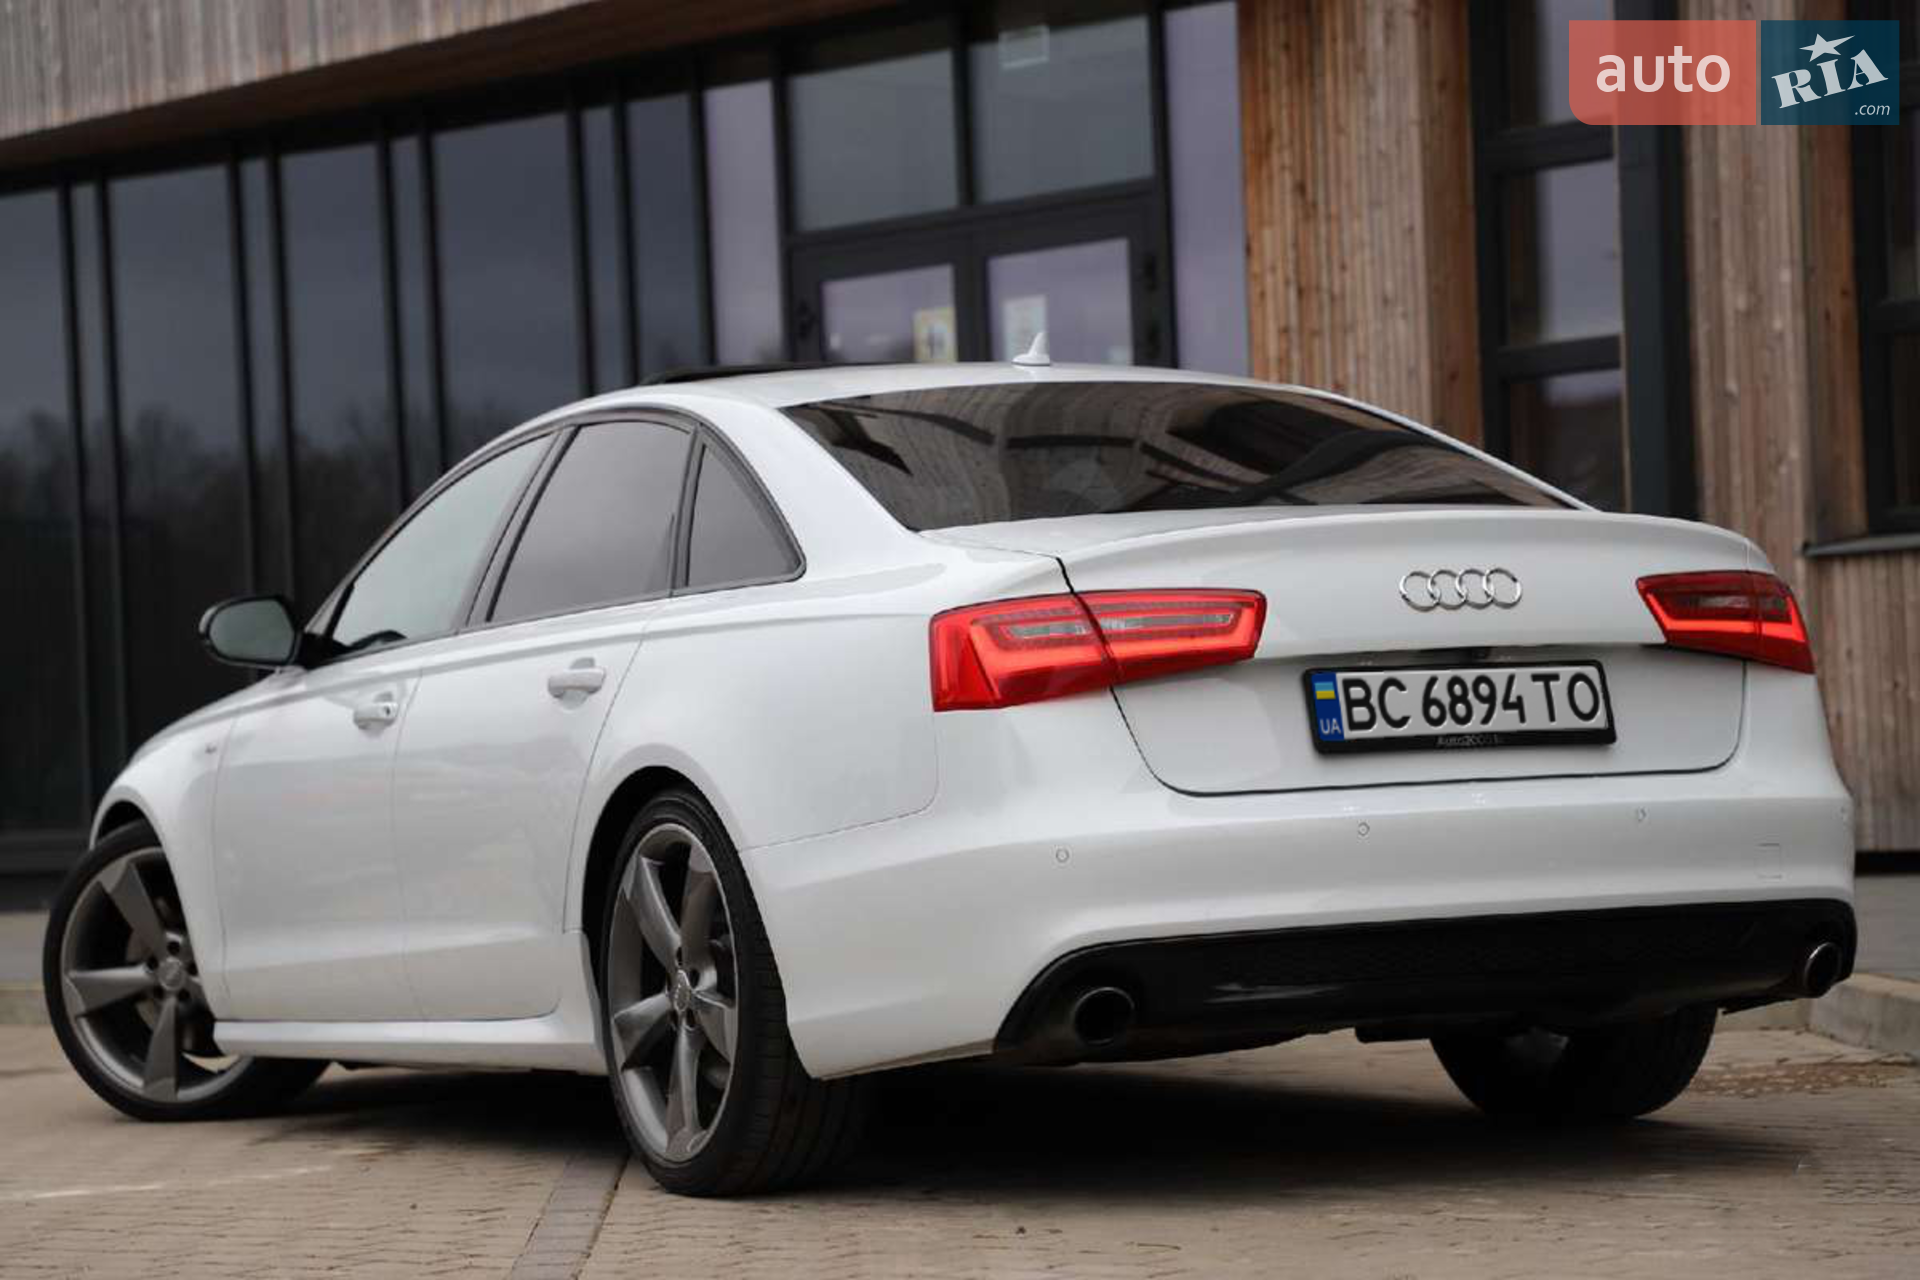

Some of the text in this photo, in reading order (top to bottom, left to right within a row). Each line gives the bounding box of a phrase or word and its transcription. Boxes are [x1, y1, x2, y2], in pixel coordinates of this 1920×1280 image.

[1341, 672, 1600, 732] BC 6894 TO
[1320, 718, 1342, 735] UA
